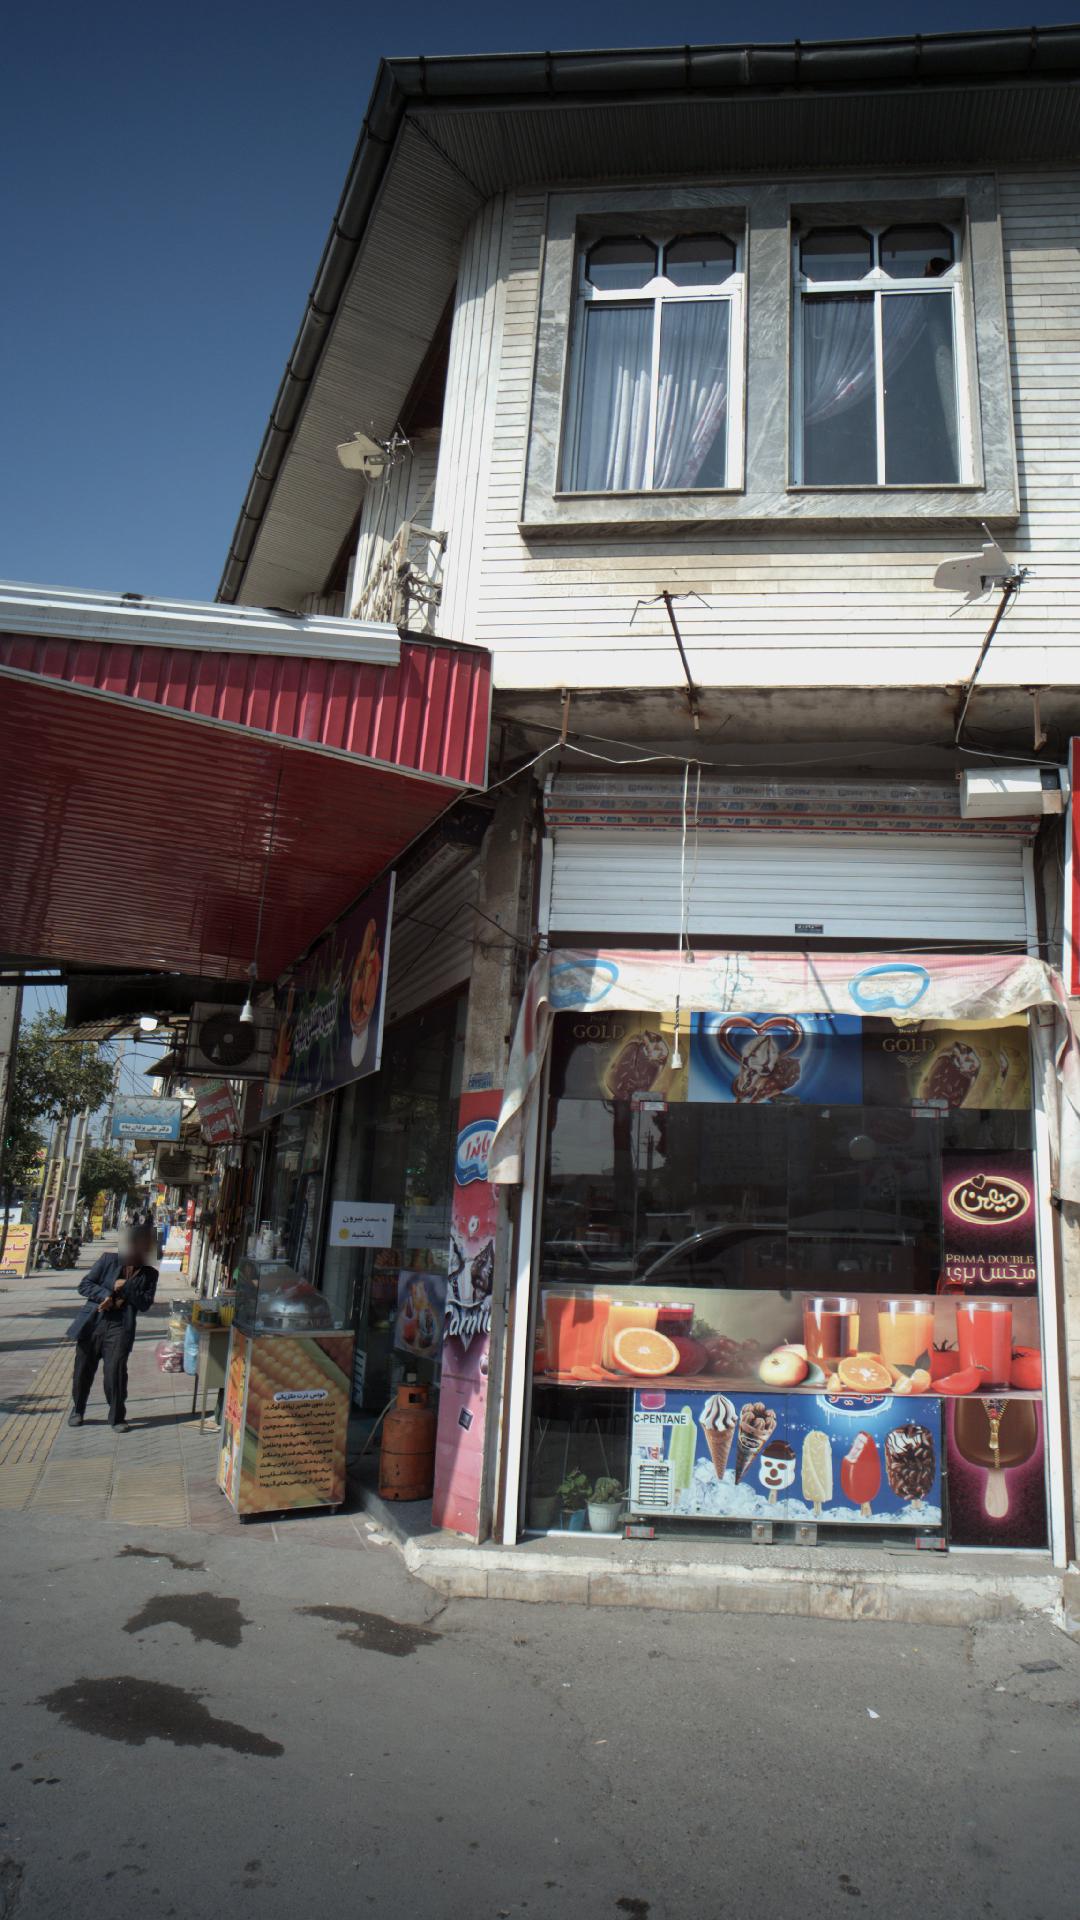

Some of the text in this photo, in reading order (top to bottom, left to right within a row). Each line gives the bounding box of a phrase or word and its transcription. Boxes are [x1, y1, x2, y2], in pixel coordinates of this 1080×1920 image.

[573, 1024, 625, 1040] GOLD
[882, 1039, 936, 1053] GOLD
[960, 1188, 1020, 1213] میهن
[945, 1253, 1035, 1265] PRIMA DOUBLE
[980, 1264, 1036, 1285] میکس
[634, 1414, 686, 1425] C-PENTANE
